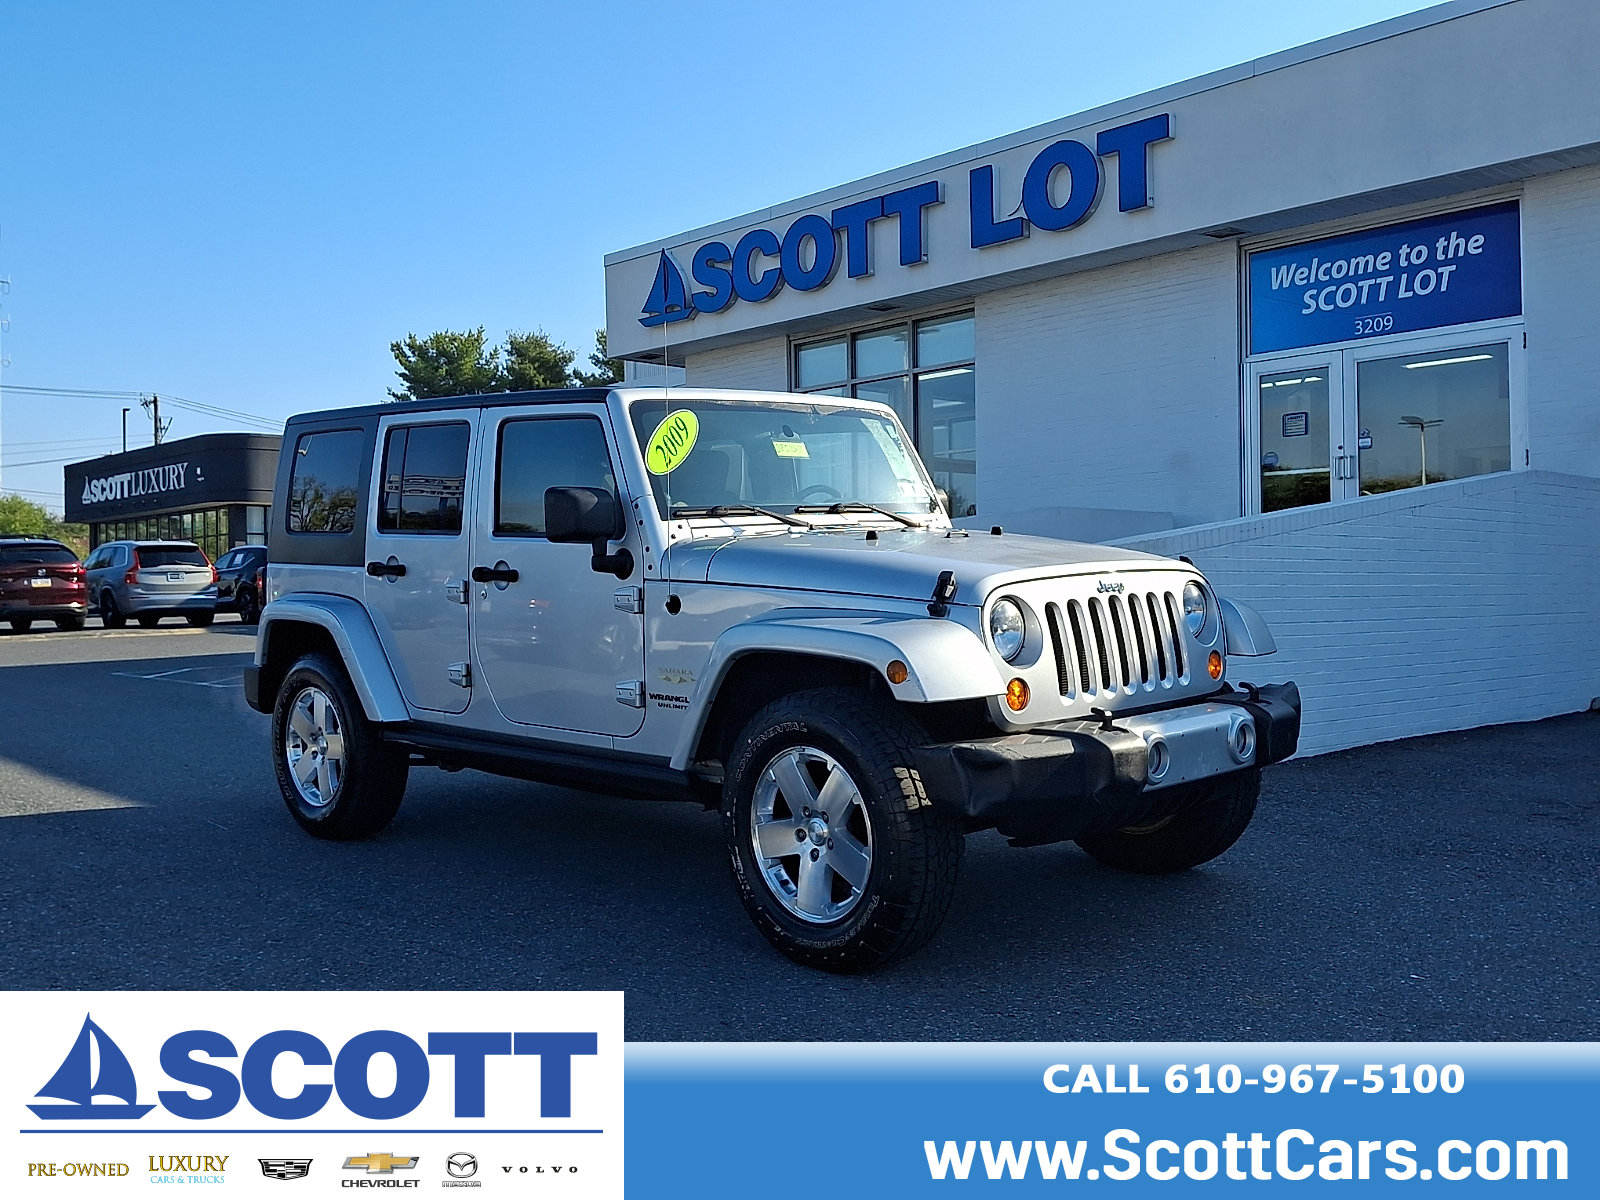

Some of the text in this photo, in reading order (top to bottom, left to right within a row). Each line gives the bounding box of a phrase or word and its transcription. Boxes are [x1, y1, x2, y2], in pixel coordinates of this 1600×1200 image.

[692, 113, 1174, 313] SCOTT LOT
[1271, 231, 1485, 290] Welcome to the
[1302, 265, 1457, 315] SCOTT LOT
[1354, 315, 1394, 335] 3209
[656, 416, 689, 469] 2009
[649, 692, 691, 704] WRANGL
[657, 702, 689, 711] UNLIMIT
